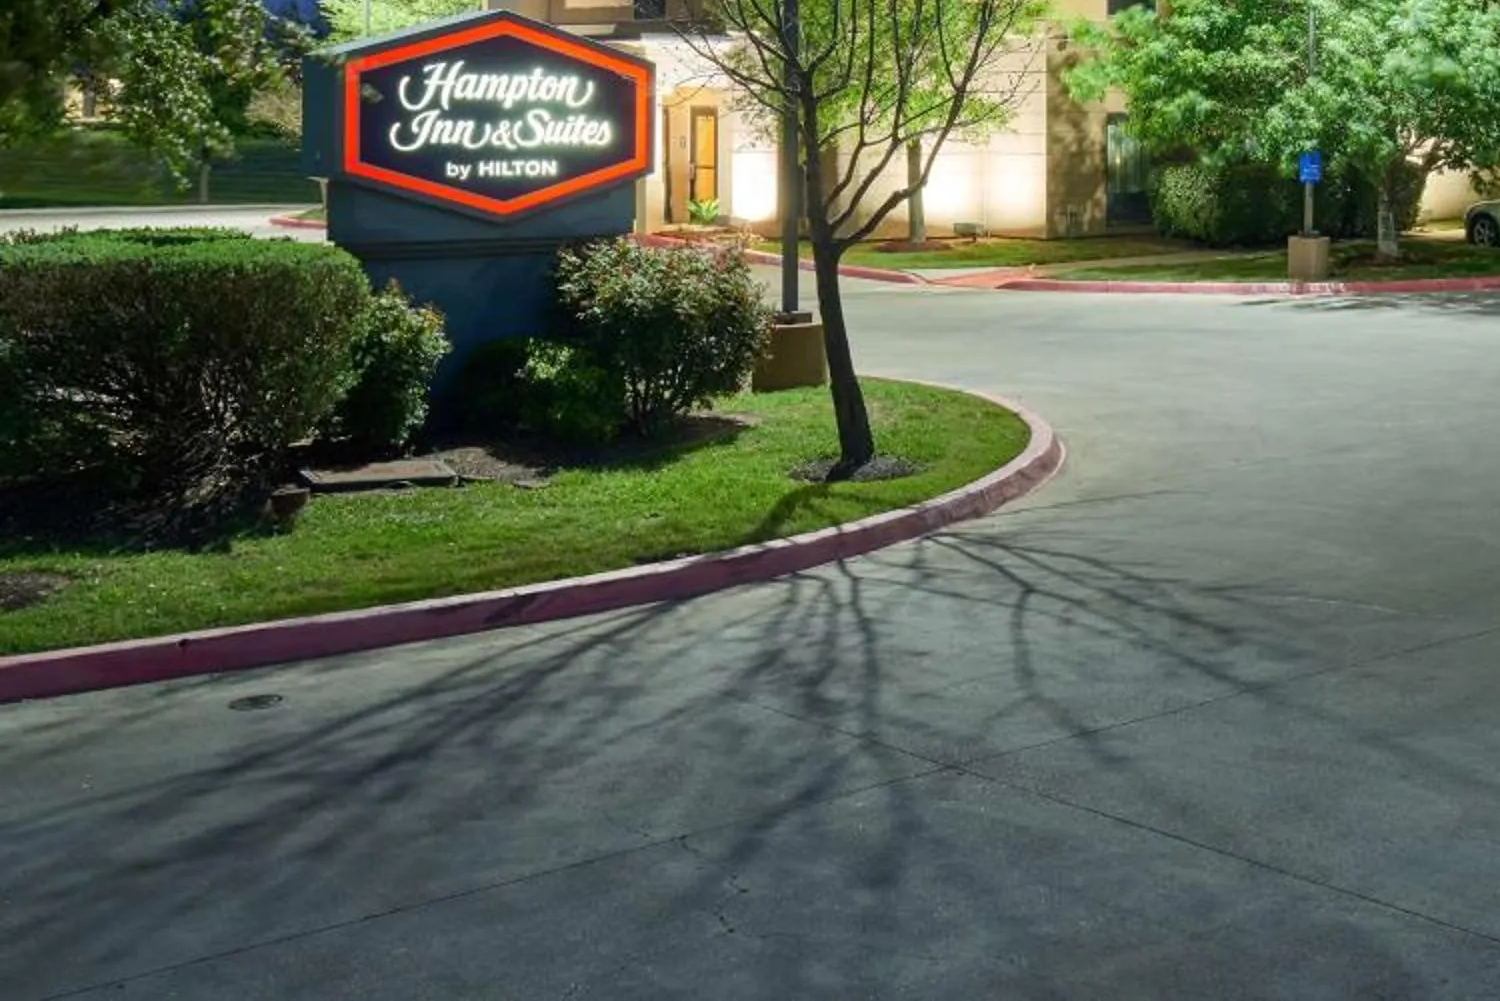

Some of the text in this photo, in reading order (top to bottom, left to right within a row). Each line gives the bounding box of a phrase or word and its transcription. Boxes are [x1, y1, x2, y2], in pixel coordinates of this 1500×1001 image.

[398, 60, 596, 111] Hampton
[389, 108, 613, 152] Inn & Suites
[445, 160, 558, 180] by HILTON
